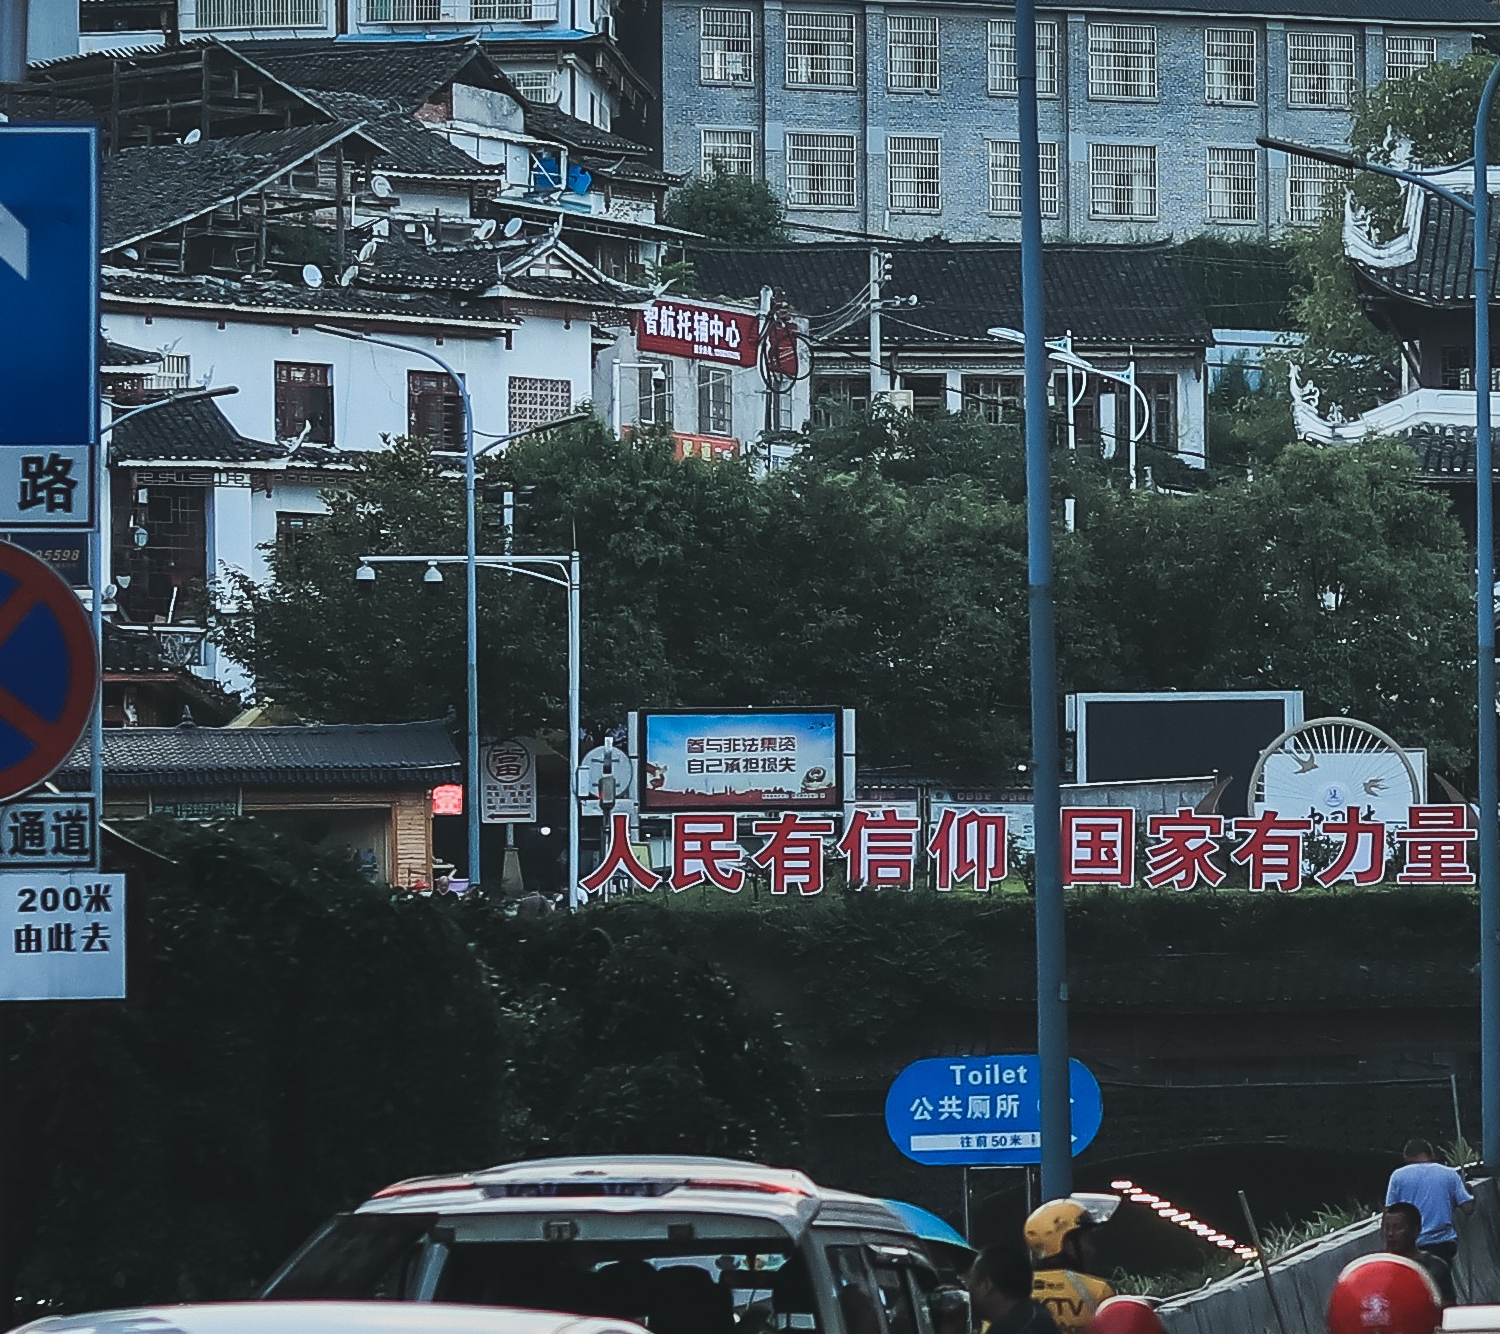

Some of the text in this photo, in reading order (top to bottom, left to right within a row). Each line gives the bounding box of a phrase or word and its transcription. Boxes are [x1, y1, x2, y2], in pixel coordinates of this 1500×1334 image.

[686, 756, 797, 775] 自己承担损失
[579, 807, 1010, 897] 人民有信仰
[1060, 803, 1478, 897] 国家有力量
[16, 882, 113, 914] 200米
[14, 921, 112, 954] 由此去
[950, 1064, 1028, 1086] Toilet
[910, 1094, 1020, 1122] 公共厕所
[960, 1134, 1023, 1149] 往前50米
